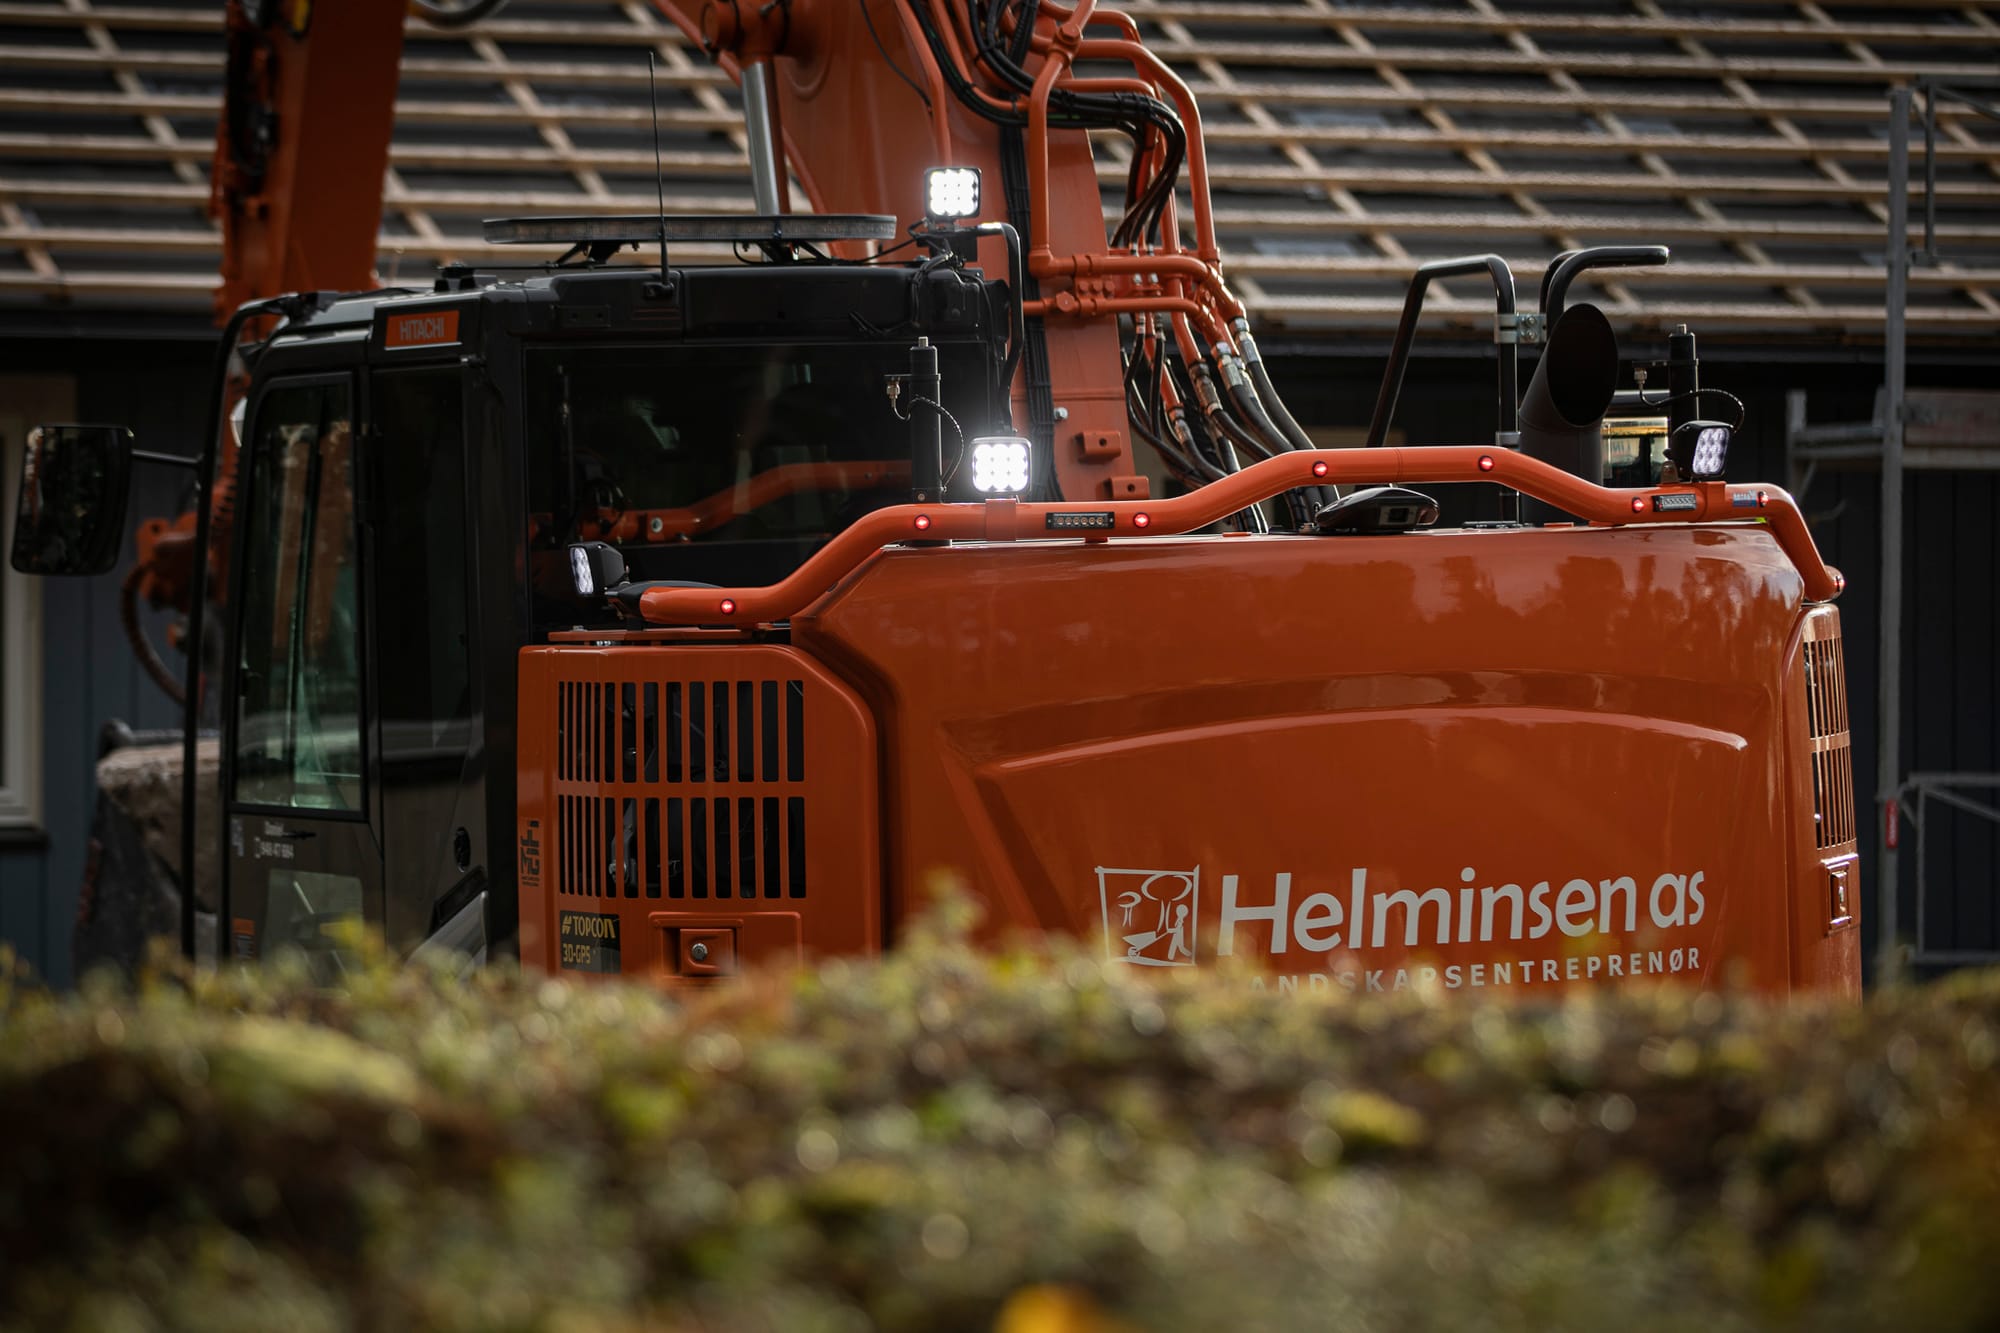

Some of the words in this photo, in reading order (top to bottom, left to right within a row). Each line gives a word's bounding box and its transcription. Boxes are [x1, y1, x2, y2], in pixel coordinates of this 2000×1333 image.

[399, 316, 446, 342] HITACHI
[1216, 866, 1636, 957] Helminsen
[1649, 870, 1706, 929] as
[1228, 946, 1700, 994] ANDSKAPSENTREPRENØR
